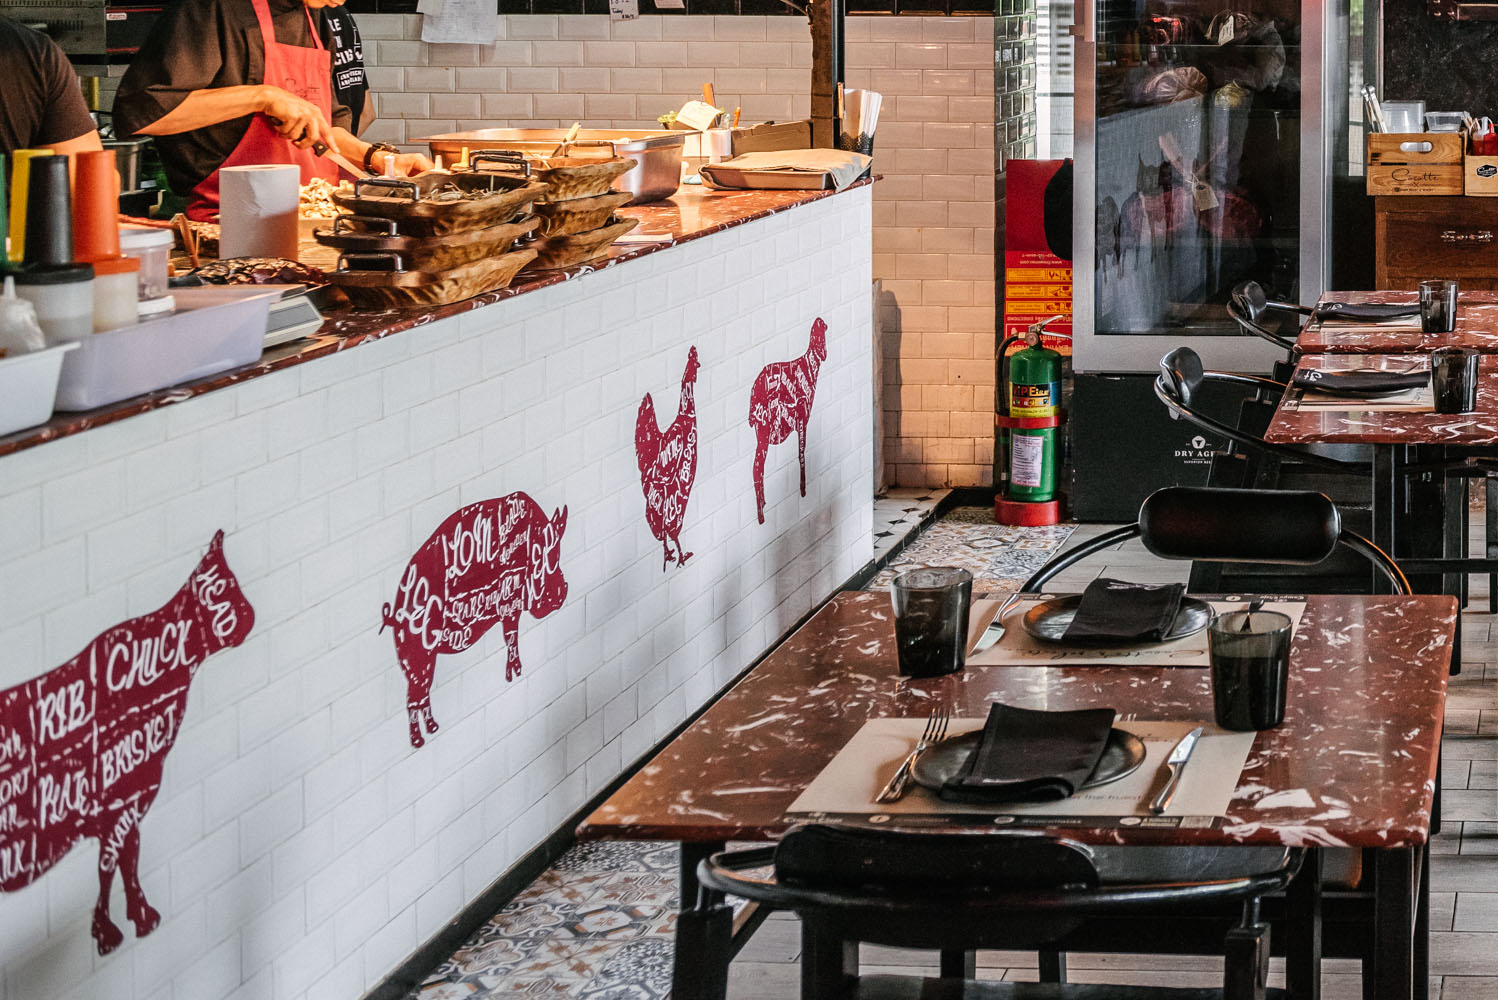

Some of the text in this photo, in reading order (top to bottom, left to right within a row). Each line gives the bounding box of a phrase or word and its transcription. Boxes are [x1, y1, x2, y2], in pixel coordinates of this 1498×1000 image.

[196, 563, 238, 647] HEAD
[395, 563, 443, 650] LEG
[106, 618, 197, 692] CHUCK
[37, 679, 93, 746] RIB
[101, 700, 178, 790] BRISKET
[39, 766, 91, 831] PLATE
